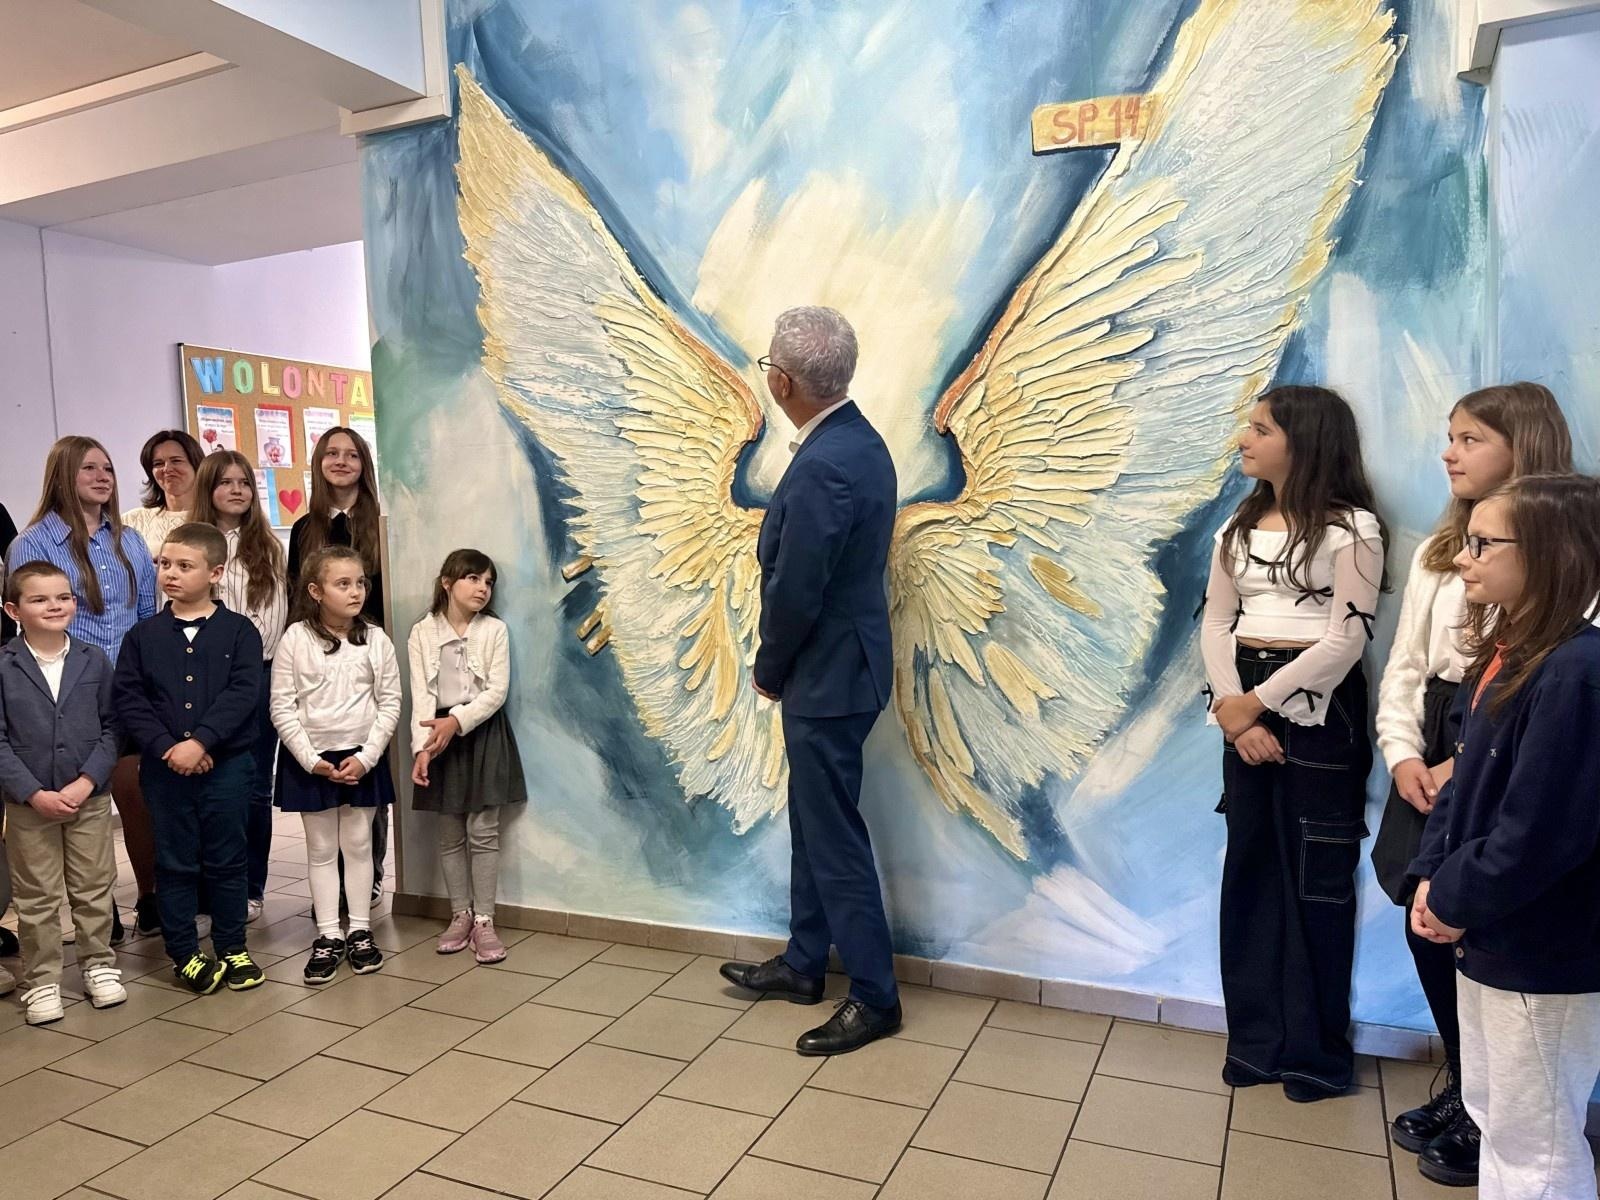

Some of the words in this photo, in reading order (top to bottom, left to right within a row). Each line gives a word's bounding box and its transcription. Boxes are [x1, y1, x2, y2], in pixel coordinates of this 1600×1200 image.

[1051, 104, 1098, 144] SP
[1109, 96, 1141, 139] 14
[190, 356, 369, 407] WOLONTA
